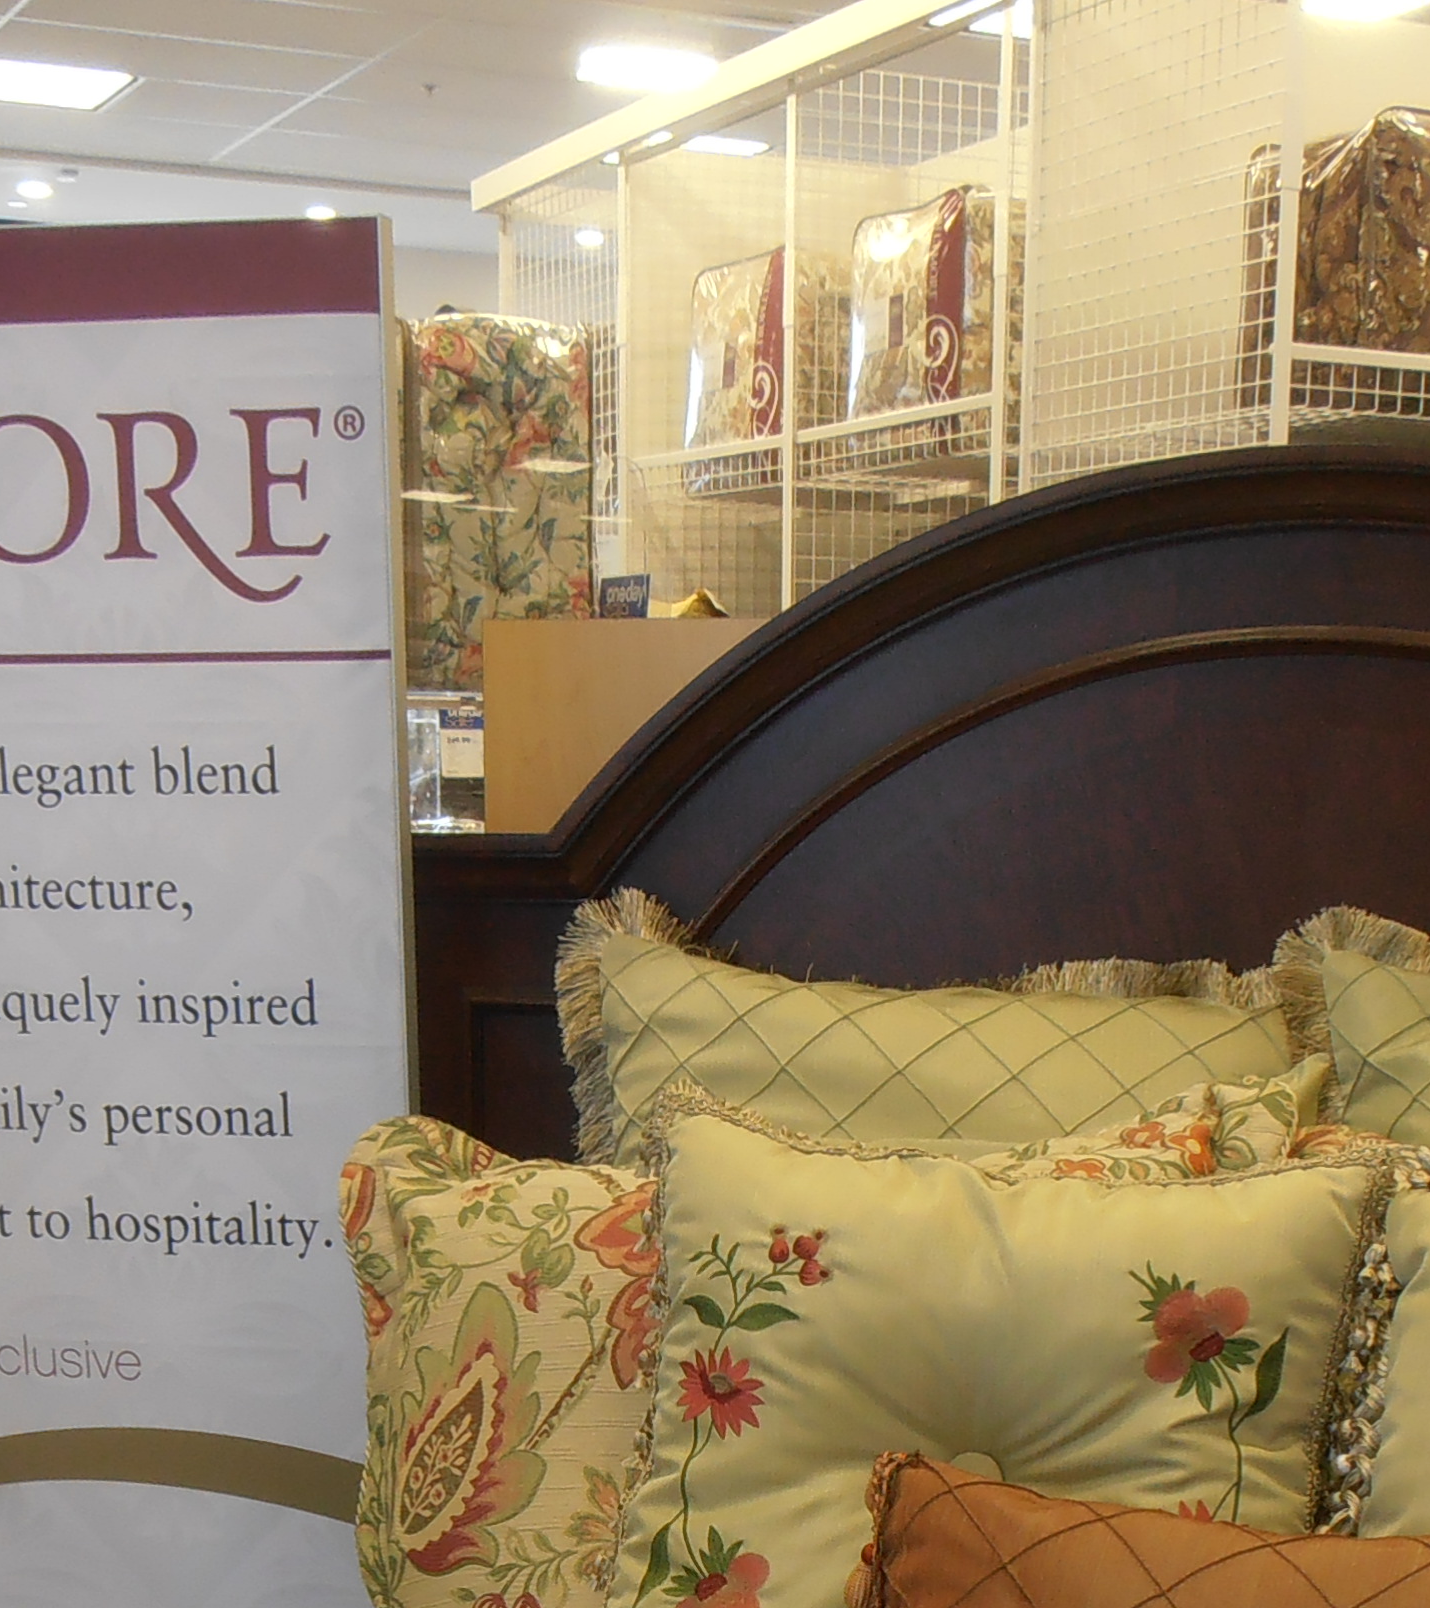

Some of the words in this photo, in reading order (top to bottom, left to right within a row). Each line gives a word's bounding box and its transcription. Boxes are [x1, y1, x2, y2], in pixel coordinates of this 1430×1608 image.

[151, 745, 280, 799] blend
[136, 977, 319, 1037] inspired
[103, 1091, 293, 1146] personal
[26, 1201, 71, 1242] to
[85, 1198, 335, 1259] hospitality.
